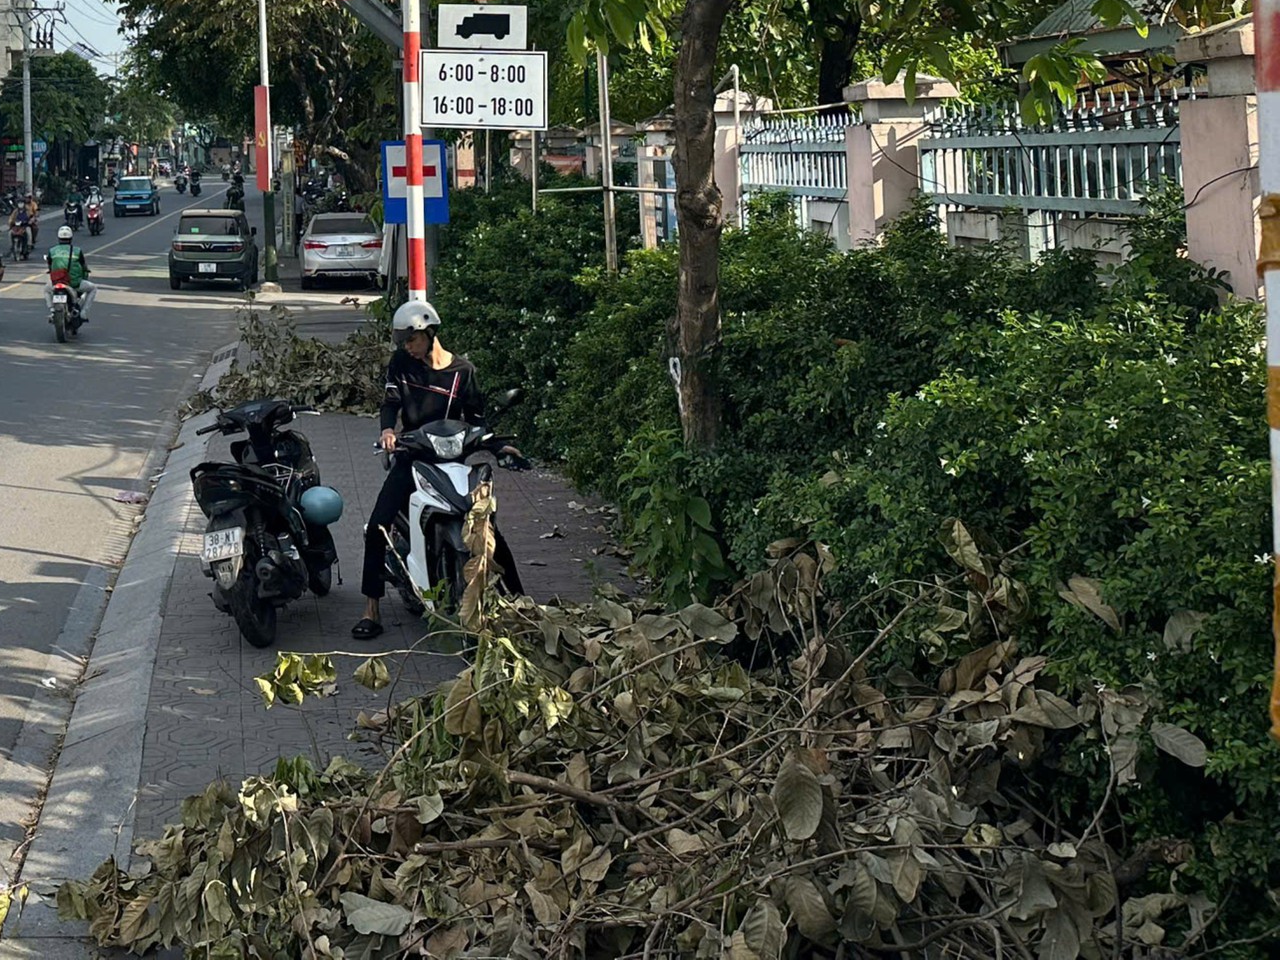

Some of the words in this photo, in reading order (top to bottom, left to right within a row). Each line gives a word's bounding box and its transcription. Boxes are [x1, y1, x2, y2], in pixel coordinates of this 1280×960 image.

[439, 64, 473, 82] 6:00
[490, 65, 525, 83] 8:00
[433, 96, 473, 115] 16:00
[491, 97, 533, 116] 18:00
